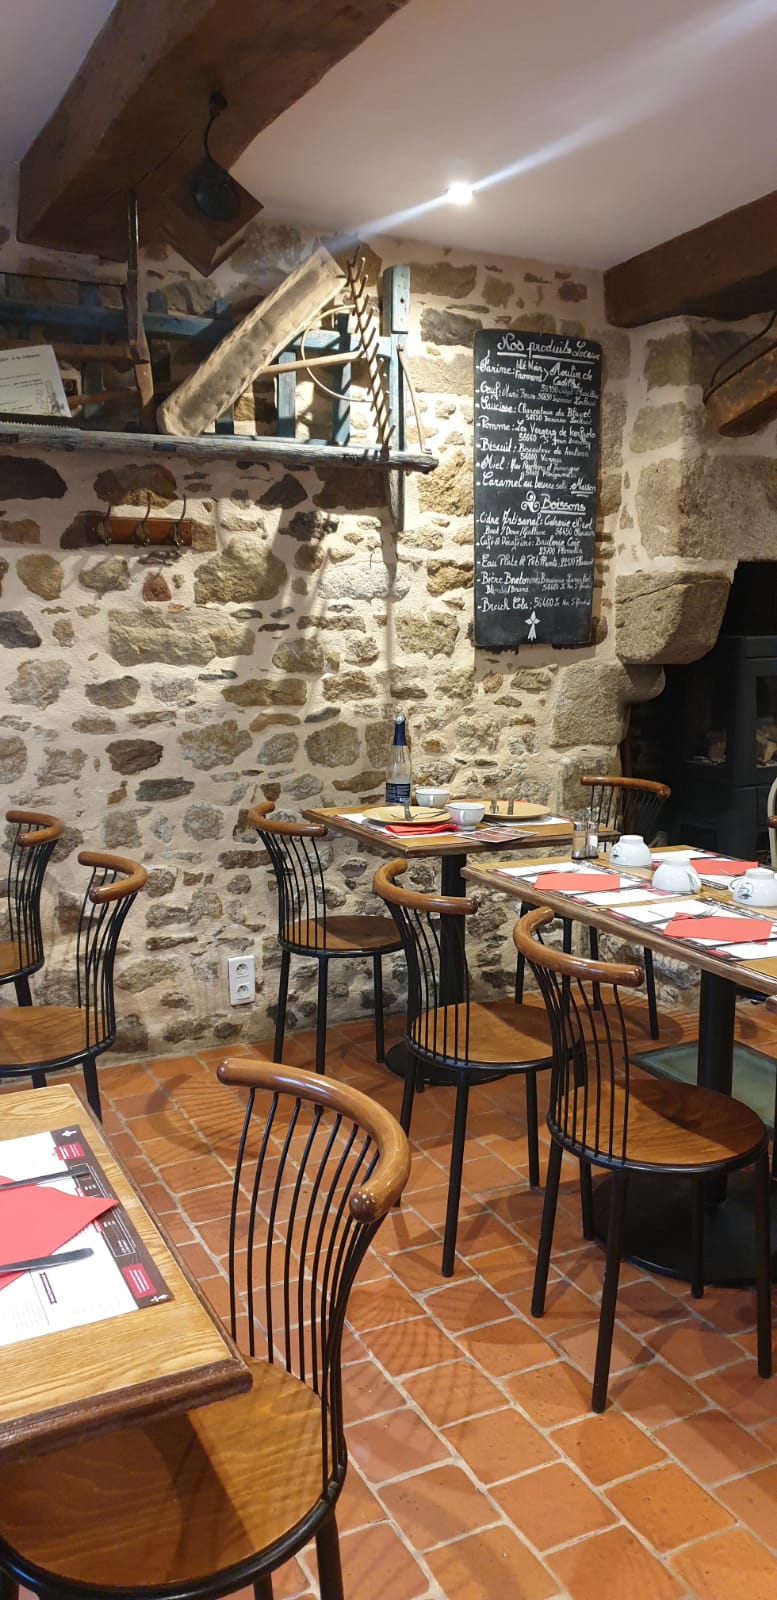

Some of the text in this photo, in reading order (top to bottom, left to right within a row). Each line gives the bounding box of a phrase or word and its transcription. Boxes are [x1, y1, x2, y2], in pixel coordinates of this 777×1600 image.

[497, 333, 524, 351] Nos
[527, 339, 571, 360] produits
[583, 369, 592, 381] de
[559, 426, 567, 437] de
[553, 446, 562, 455] de
[523, 480, 532, 488] au
[540, 493, 586, 512] Boissons
